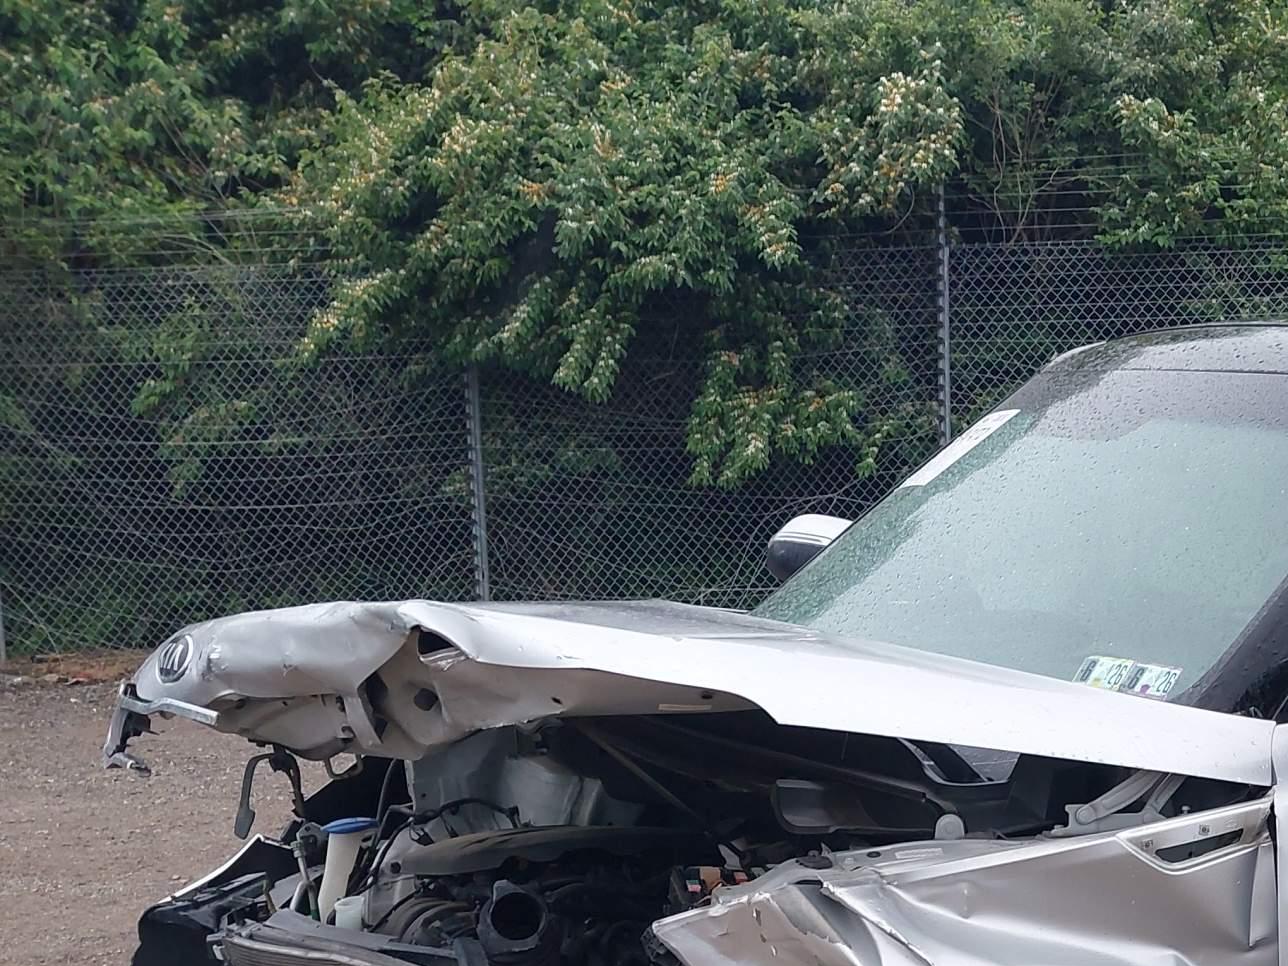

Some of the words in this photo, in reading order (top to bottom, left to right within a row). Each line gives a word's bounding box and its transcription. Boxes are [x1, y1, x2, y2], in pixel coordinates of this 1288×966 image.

[1080, 660, 1098, 682] 6
[1107, 664, 1129, 686] 26
[1127, 668, 1146, 690] 6
[1156, 671, 1178, 694] 26
